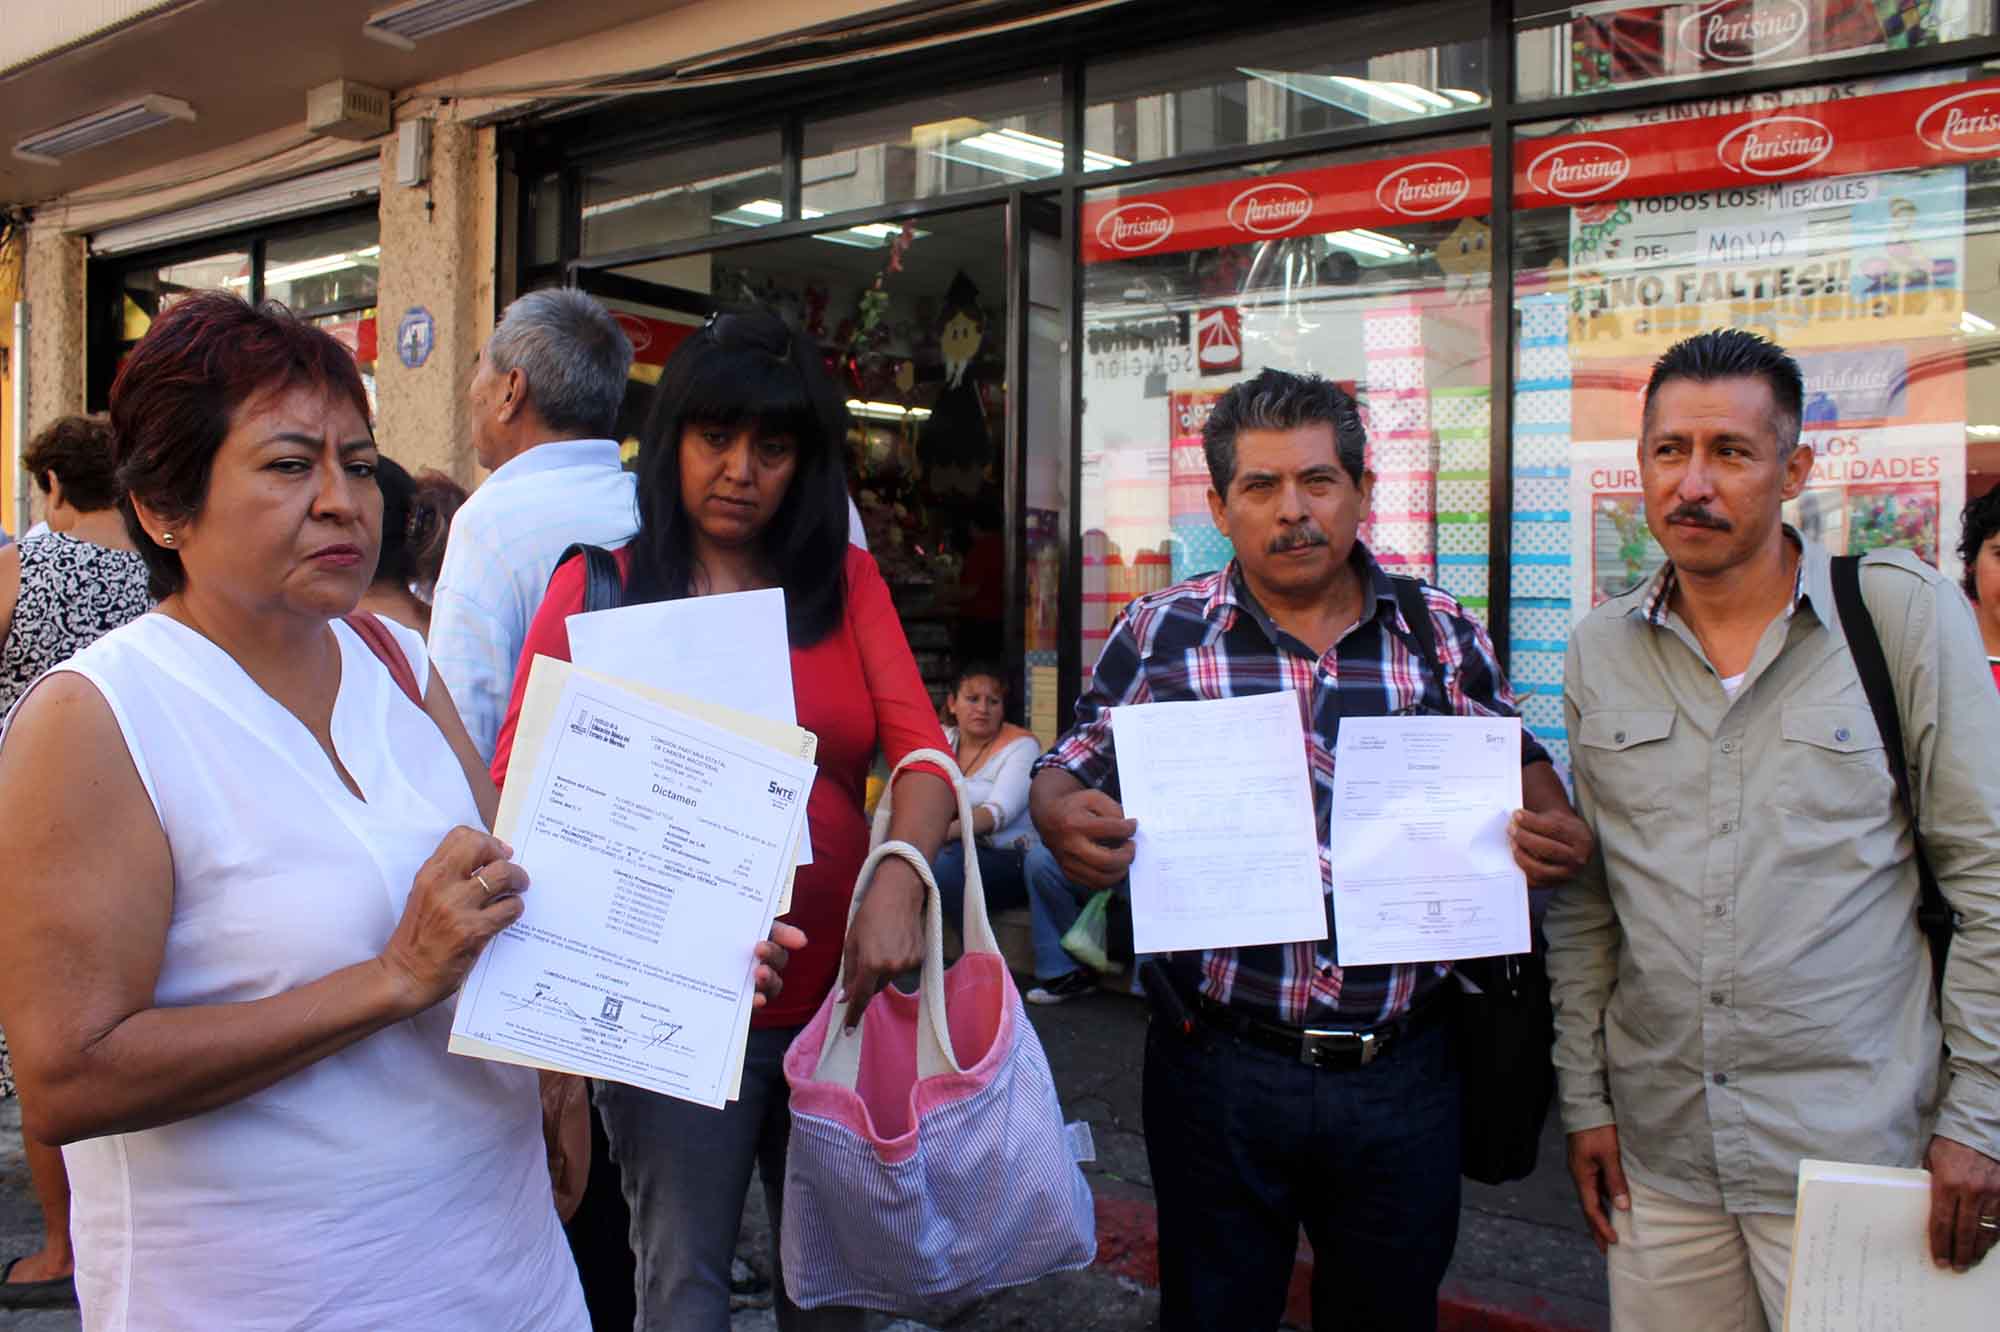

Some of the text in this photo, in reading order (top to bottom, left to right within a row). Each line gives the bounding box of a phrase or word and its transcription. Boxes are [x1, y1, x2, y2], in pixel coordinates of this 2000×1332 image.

[1704, 14, 1796, 44] Parisina
[1742, 133, 1825, 161] Parisina
[1549, 155, 1623, 184] Parisina
[1396, 175, 1461, 203] Parisina
[1635, 192, 1710, 214] TODOS
[1715, 188, 1764, 209] LOS:
[1245, 196, 1307, 224] Parisina
[1112, 215, 1167, 241] Parisina
[1634, 244, 1669, 262] DE:
[1812, 436, 1860, 457] LOS
[651, 783, 697, 808] Dictamen
[767, 780, 794, 801] SNTE
